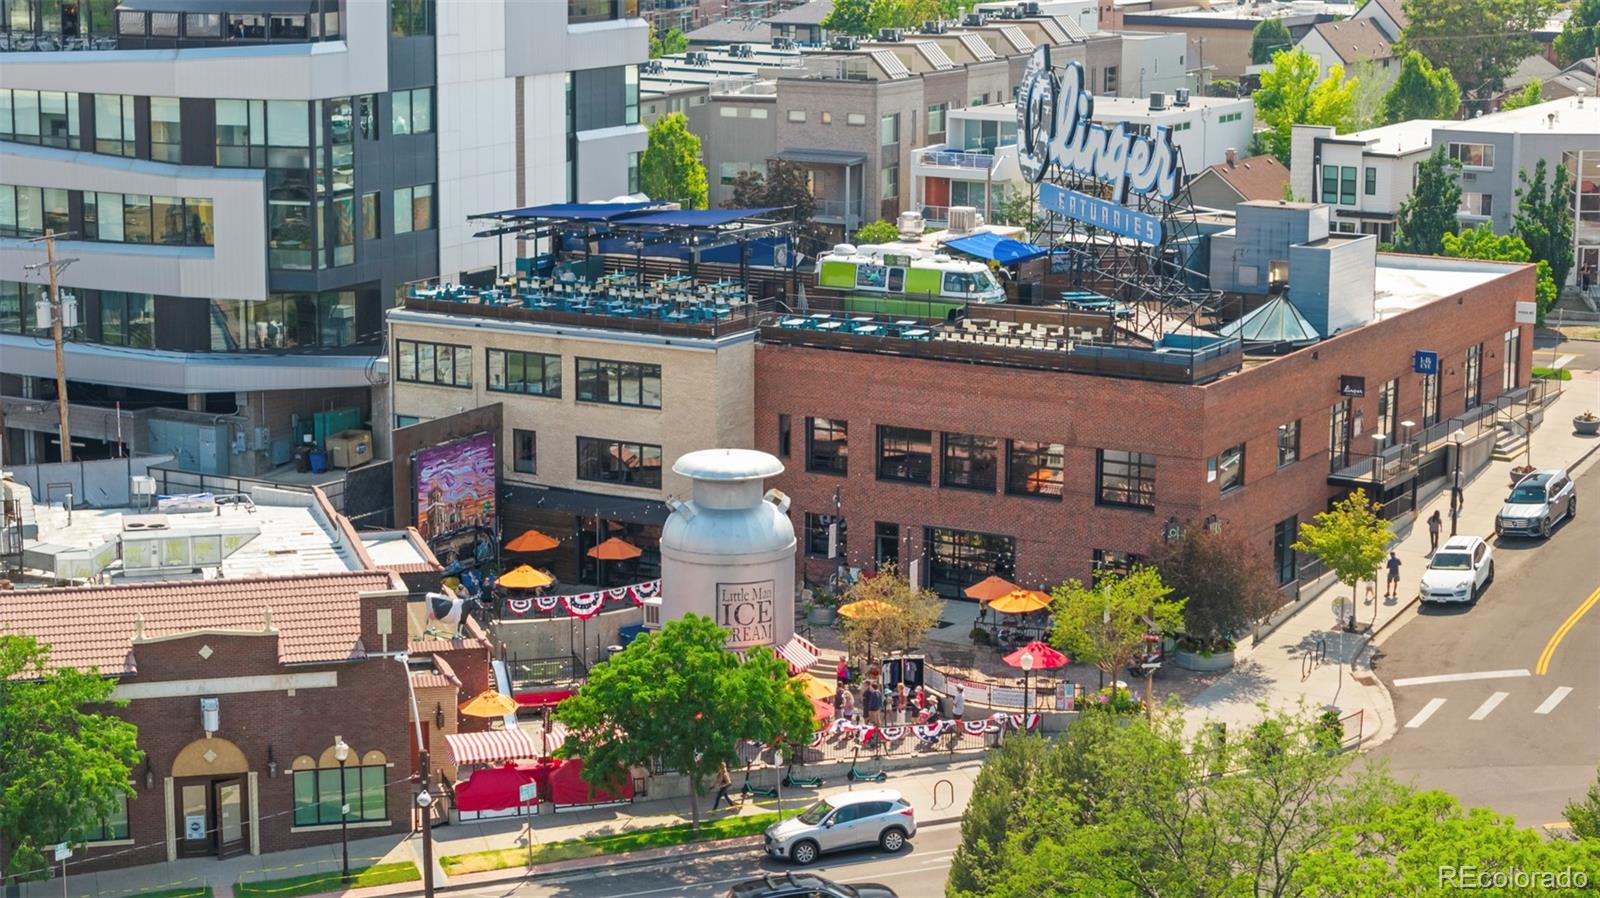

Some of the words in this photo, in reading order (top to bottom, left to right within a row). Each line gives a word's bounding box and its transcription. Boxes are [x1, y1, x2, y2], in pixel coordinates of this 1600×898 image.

[721, 587, 749, 602] Little
[752, 587, 772, 600] Man
[721, 600, 772, 626] ICE
[727, 624, 772, 642] REAM
